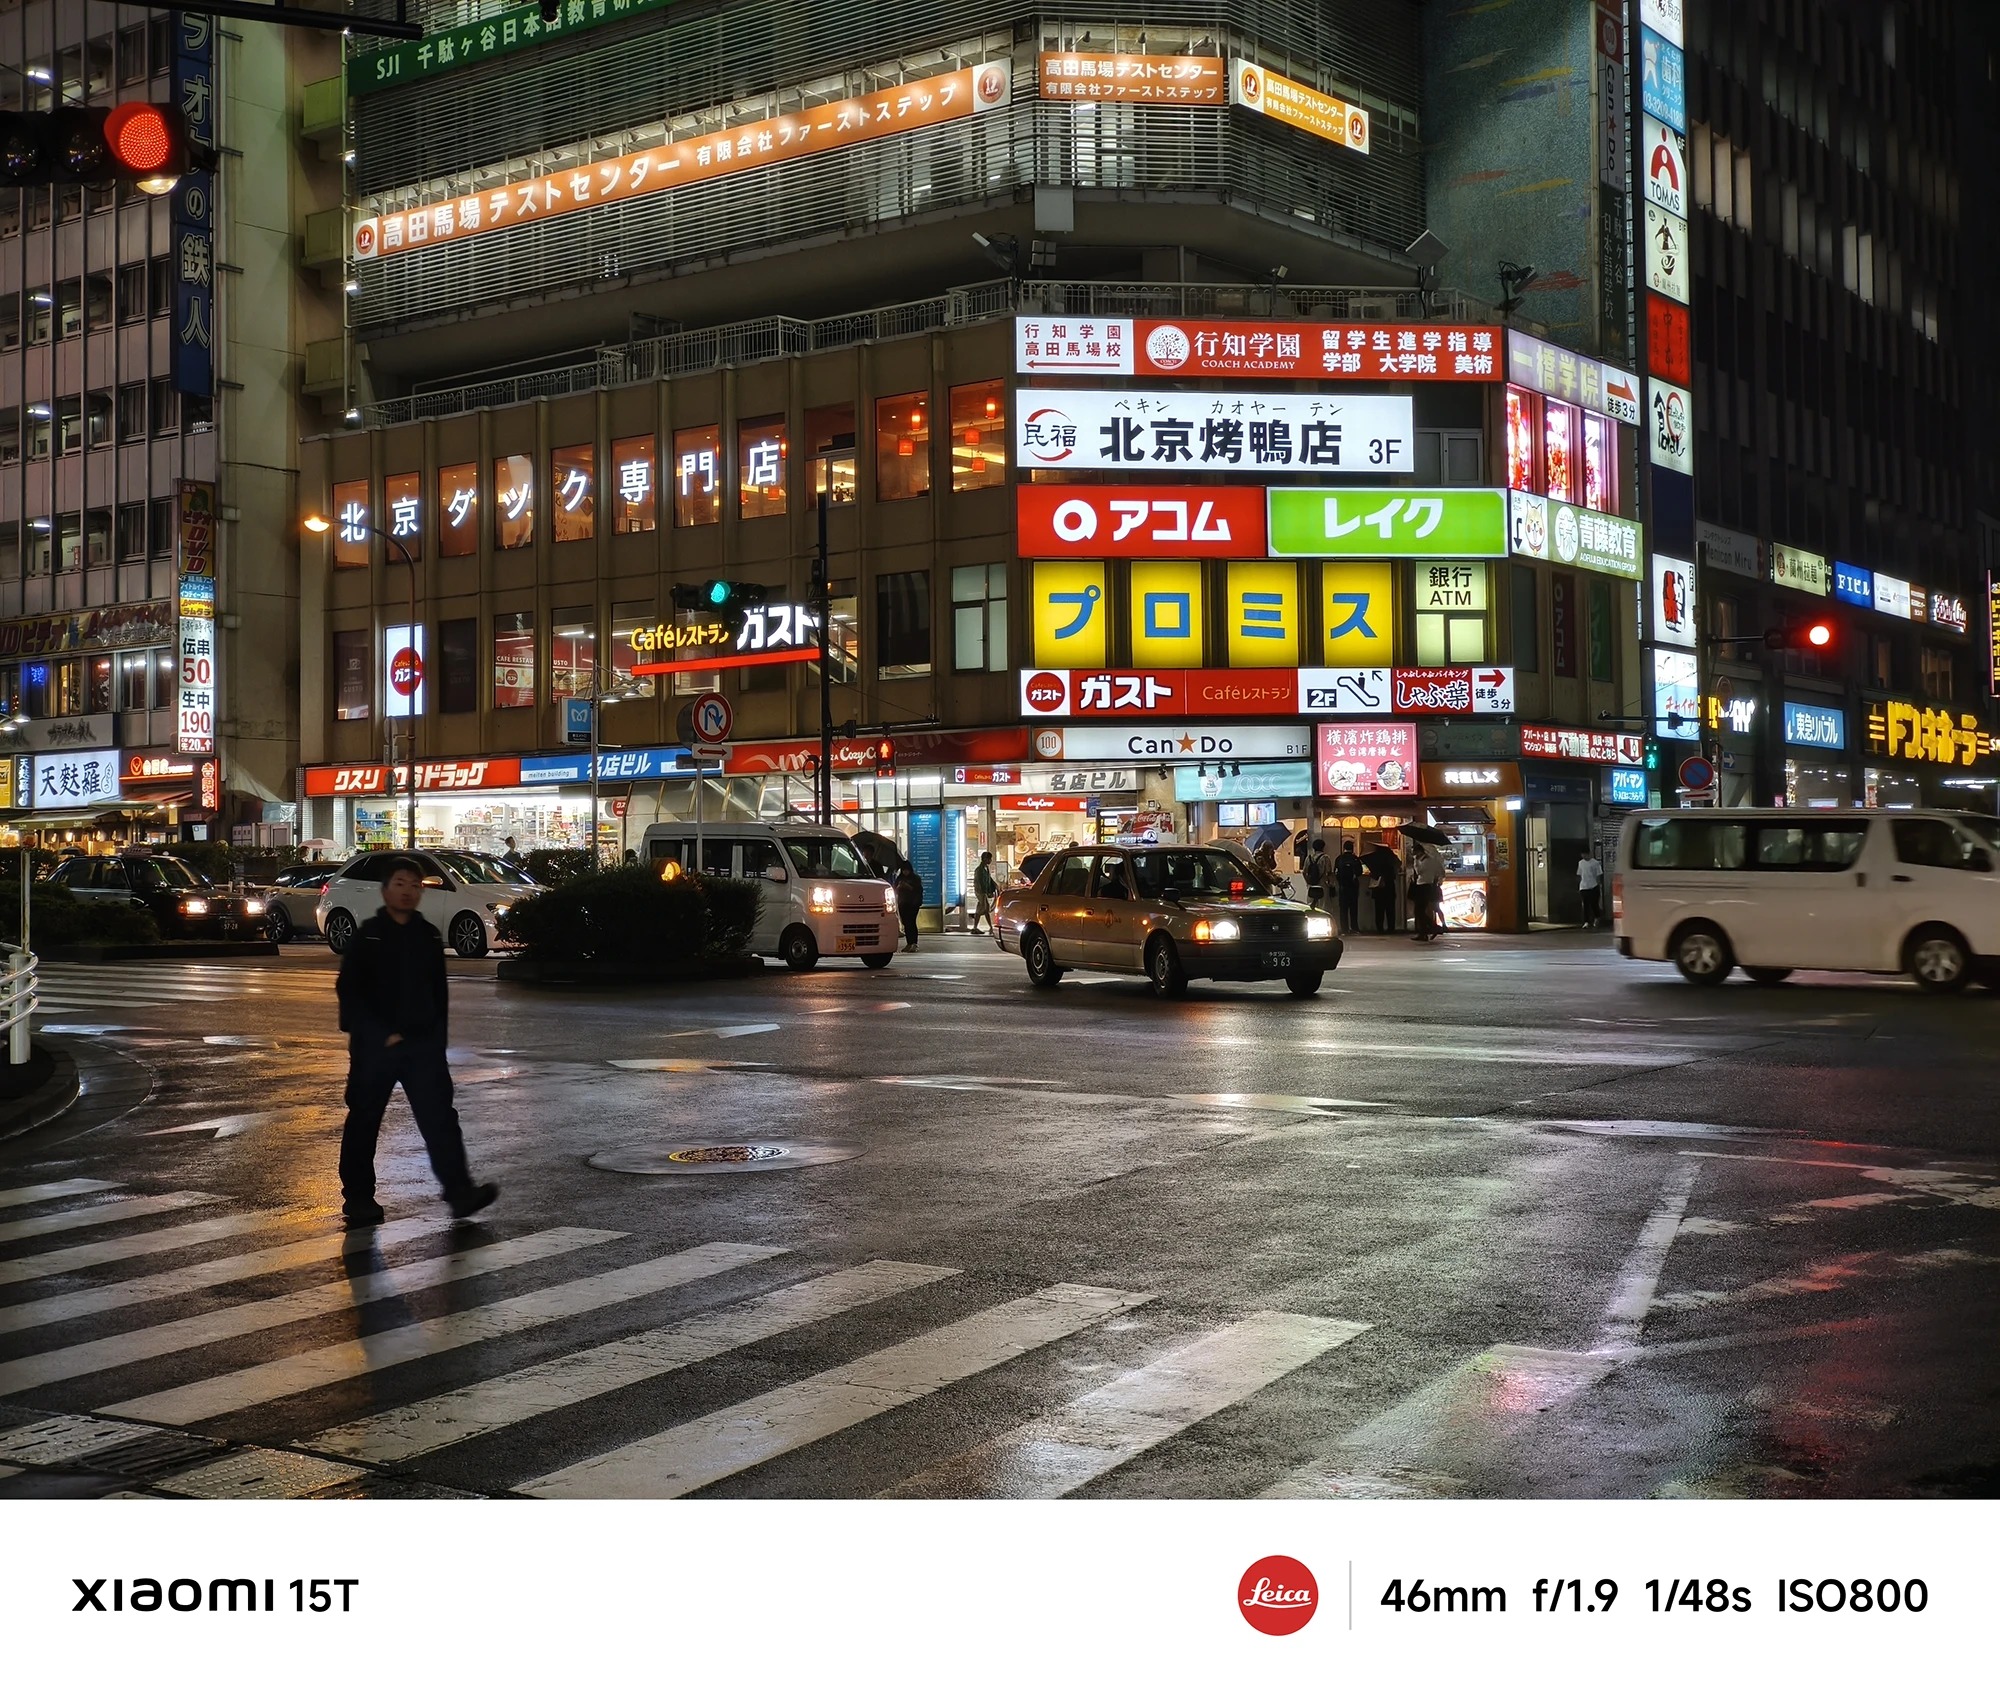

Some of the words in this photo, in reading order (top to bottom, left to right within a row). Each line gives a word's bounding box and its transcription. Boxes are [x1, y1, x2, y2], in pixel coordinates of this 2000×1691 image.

[377, 54, 400, 80] SJI
[1045, 58, 1218, 79] 高田馬場テストセンター
[1661, 55, 1682, 91] 歯科
[1045, 81, 1218, 99] 有限会社ファーストステップ
[1265, 77, 1344, 118] 高田馬場テストセンター
[1265, 96, 1344, 136] 有限会社ファーストステップ
[383, 156, 680, 250] 高田馬場テストセンター
[697, 82, 957, 168] 有限会社ファーストステップ
[1651, 181, 1680, 210] TOMAS
[1025, 323, 1121, 340] 行知学園
[1322, 330, 1492, 351] 留学生進学指導
[1025, 341, 1121, 357] 高田馬場校
[1194, 331, 1300, 359] 行知学園
[1201, 359, 1241, 368] COACH
[1243, 360, 1295, 370] ACADEMY
[1322, 352, 1361, 373] 学部
[1379, 354, 1437, 373] 大学院
[1455, 354, 1493, 374] 美術
[1512, 344, 1599, 408] 一橋学院
[1114, 398, 1170, 414] ペキン
[1211, 400, 1286, 415] カオヤー
[1309, 402, 1344, 417] テン
[1607, 397, 1636, 421] 徒歩3分
[1023, 423, 1077, 447] 民福
[1100, 417, 1342, 466] 北京烤鴨店
[1368, 438, 1402, 465] 3F
[1109, 500, 1232, 541] アコム
[1324, 497, 1444, 538] レイク
[1579, 513, 1636, 560] 青藤教育
[185, 525, 209, 574] DVD
[1596, 555, 1621, 570] EDUCATION
[1621, 561, 1636, 573] GROUP
[1428, 566, 1473, 588] 銀行
[1429, 590, 1472, 606] ATM
[1048, 584, 1378, 640] プロミス
[631, 623, 730, 652] Caféレストラン
[736, 605, 820, 650] ガスト
[183, 637, 210, 655] 伝串
[182, 657, 210, 684] 50
[1396, 669, 1469, 679] しゃぶしゃぶバイキング
[182, 691, 210, 709] 生中
[1031, 688, 1062, 701] ガスト
[1079, 674, 1172, 709] ガスト
[1202, 685, 1290, 700] Caféレストラン
[1309, 690, 1336, 707] 2F
[1396, 680, 1470, 710] しゃぶ葉
[1475, 688, 1498, 699] 徒歩
[1491, 698, 1511, 710] 3分
[181, 710, 211, 734] 190
[1796, 711, 1838, 744] 東急リバブル
[1040, 735, 1057, 750] 100
[1286, 744, 1308, 755] B1F
[1348, 746, 1387, 757] 台湾唐揚
[1557, 731, 1591, 758] 不動産
[1590, 747, 1617, 760] のことなら
[587, 752, 651, 777] 名店ビル
[334, 769, 380, 791] クスリ
[992, 771, 1011, 783] ガスト
[1050, 771, 1126, 791] 名店ビル
